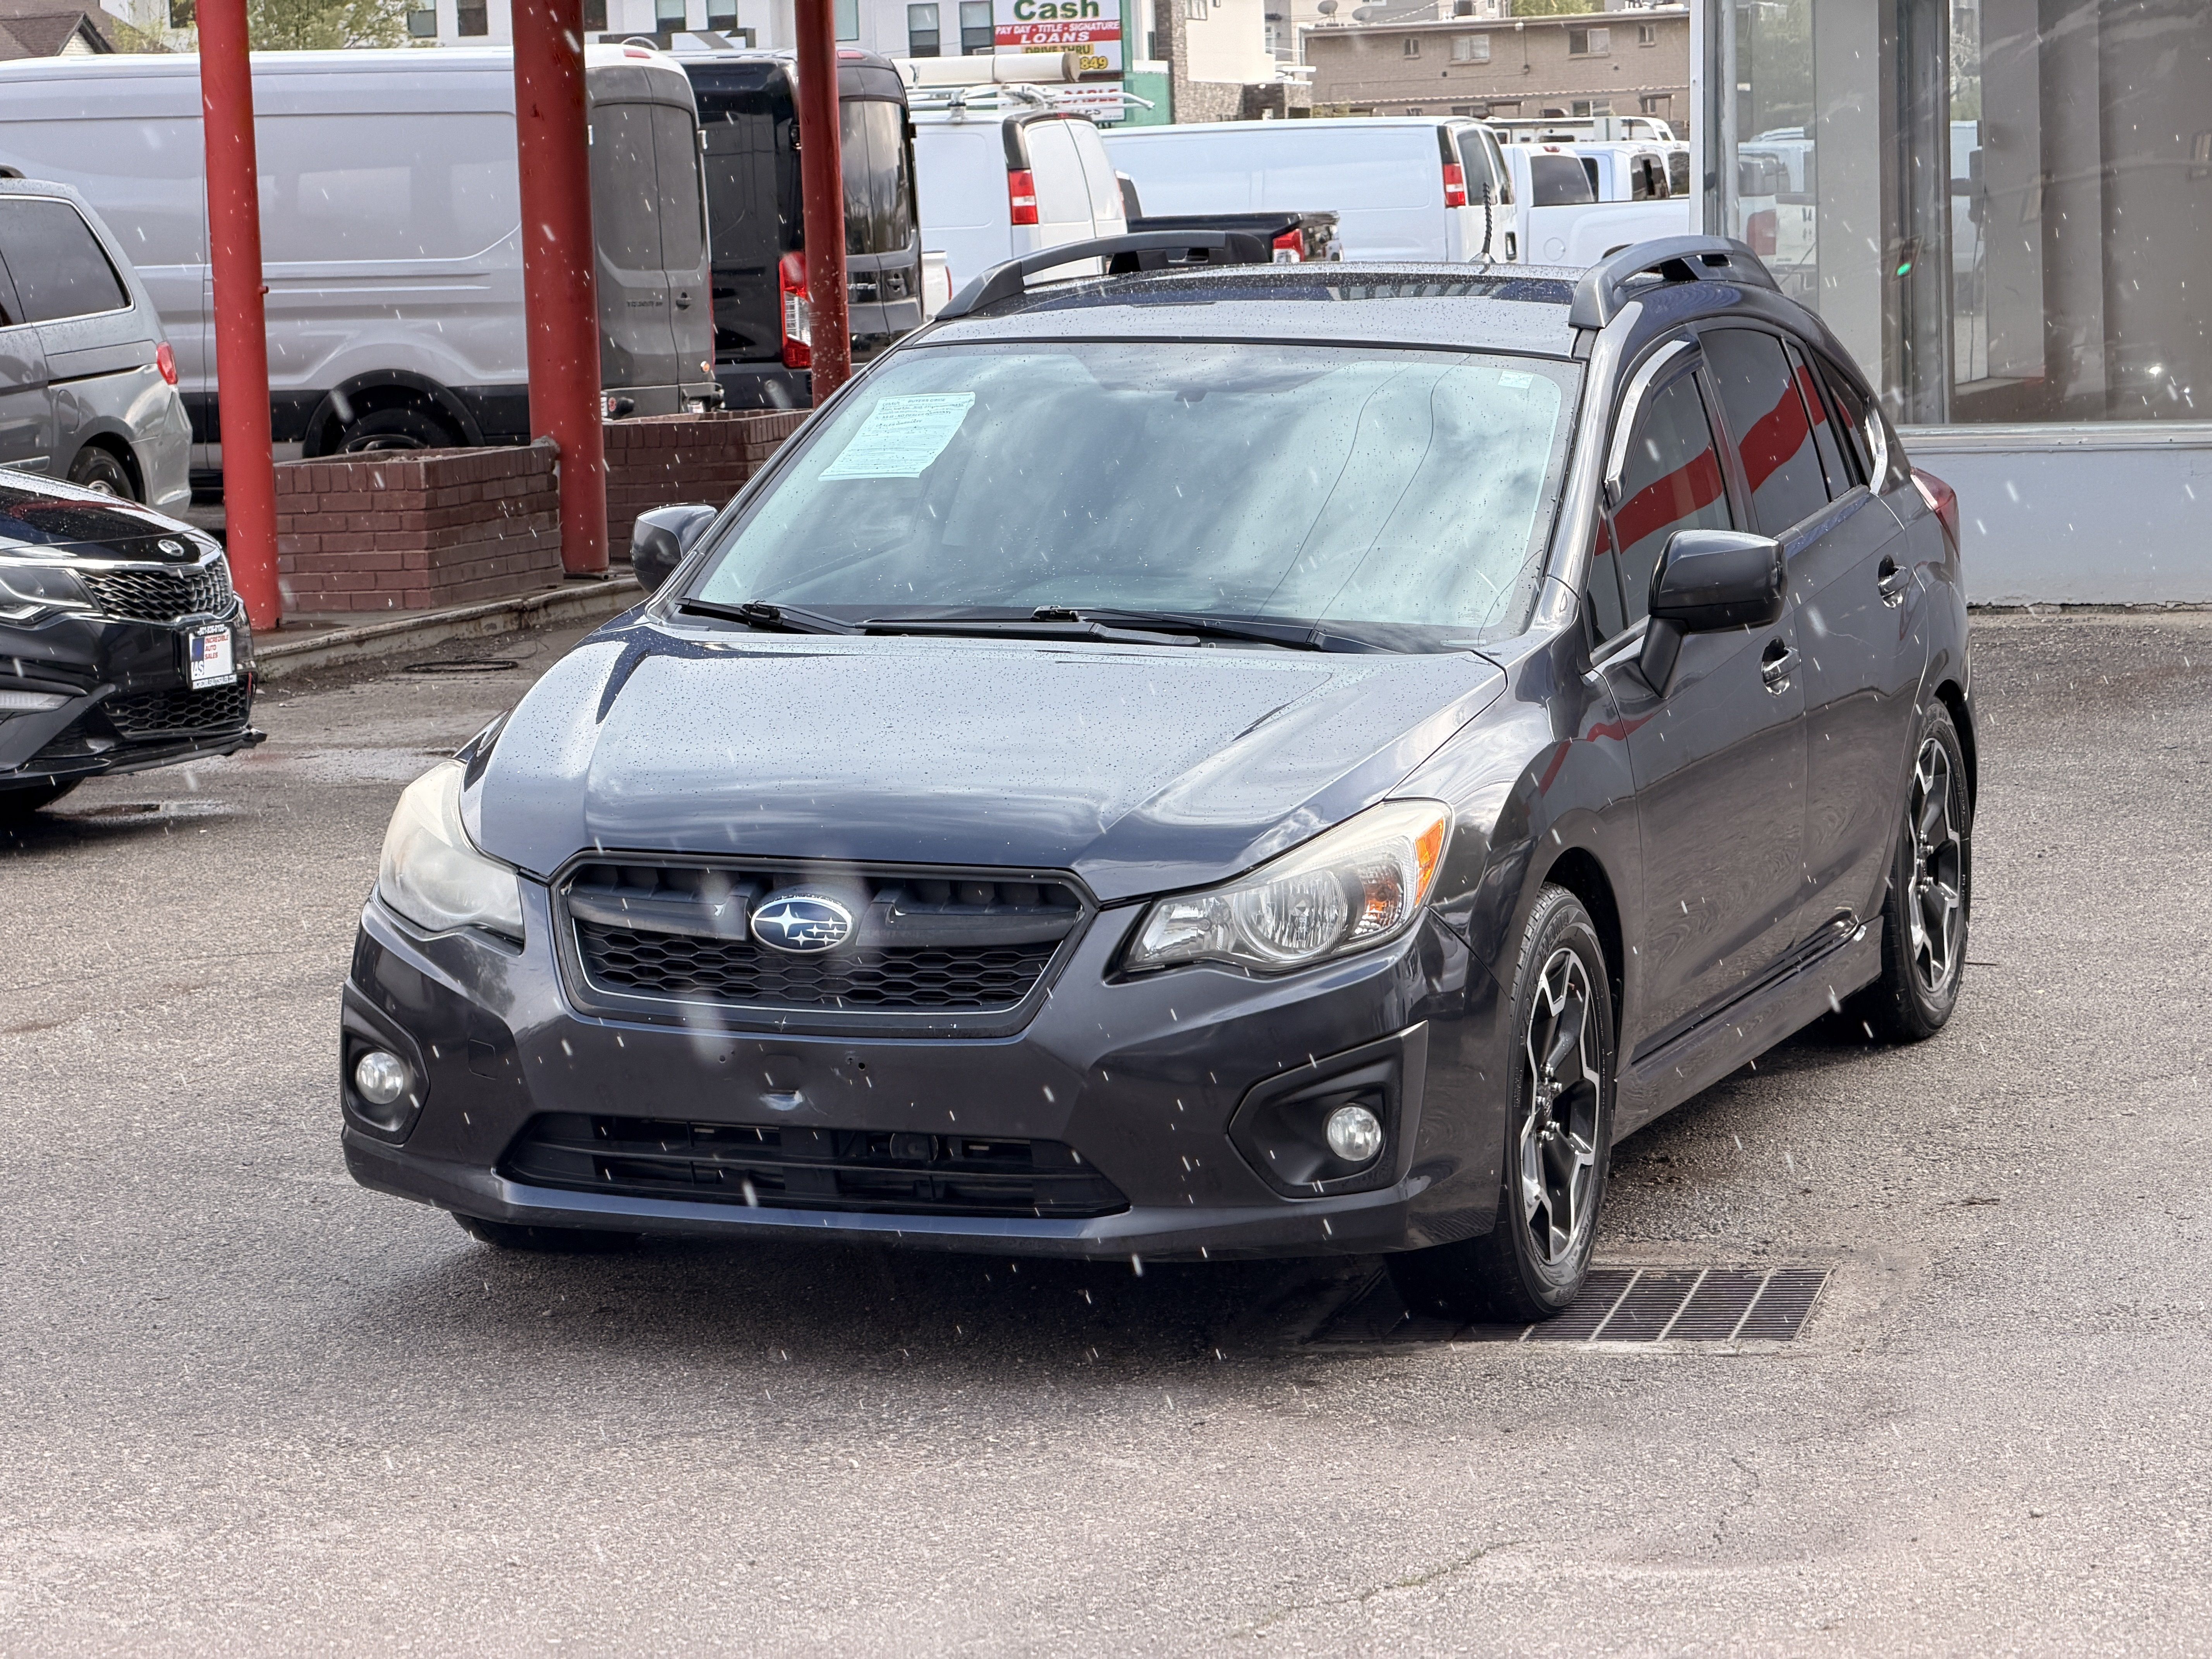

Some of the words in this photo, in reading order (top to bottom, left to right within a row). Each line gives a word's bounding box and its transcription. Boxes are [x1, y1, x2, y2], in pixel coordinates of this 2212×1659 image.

[1014, 0, 1099, 20] Cash
[995, 26, 1012, 35] PAY
[1013, 25, 1032, 34] DAY
[1037, 23, 1063, 33] TITLE
[1069, 21, 1120, 32] SIGNATURE
[1020, 31, 1090, 44] LOANS
[205, 634, 229, 644] INCREDIBLE
